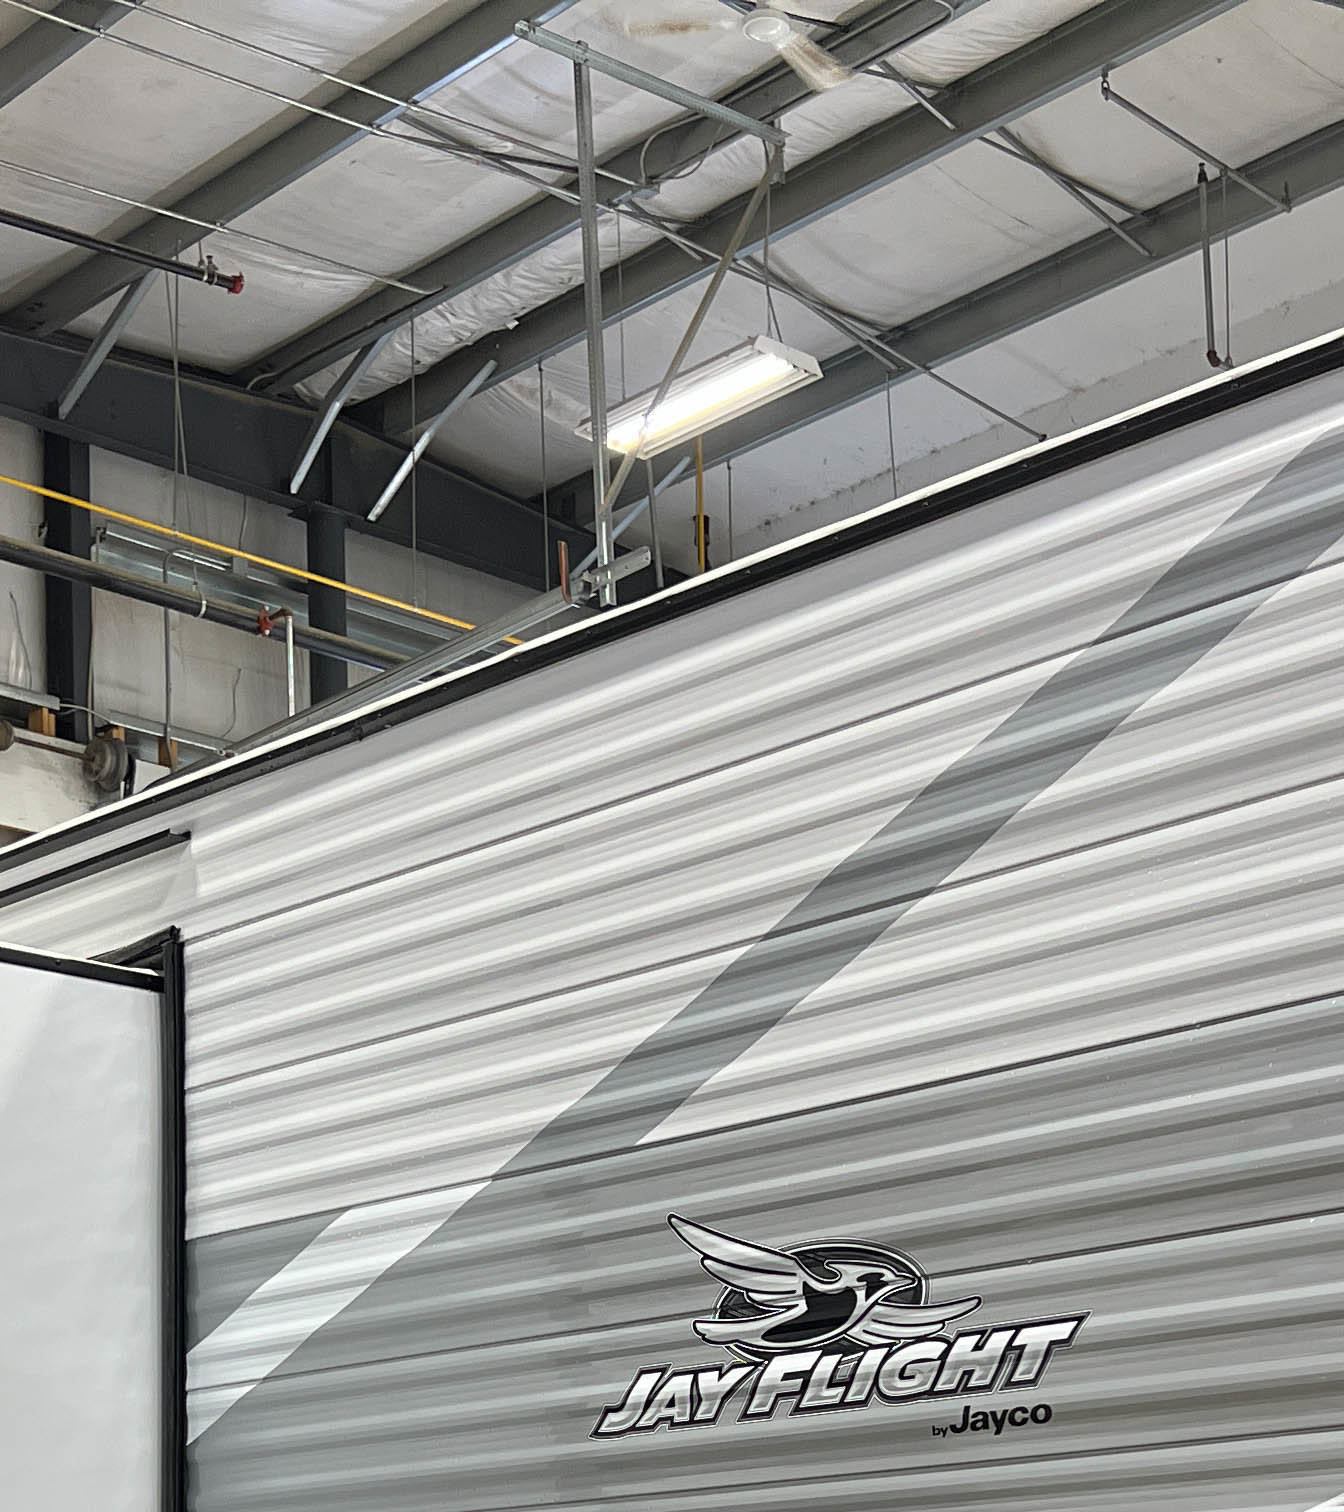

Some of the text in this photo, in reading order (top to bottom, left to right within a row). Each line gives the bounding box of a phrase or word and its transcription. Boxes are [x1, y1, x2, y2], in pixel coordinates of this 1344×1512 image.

[589, 1310, 1092, 1440] JAY FLIGHT
[932, 1402, 1053, 1438] by Jayco
